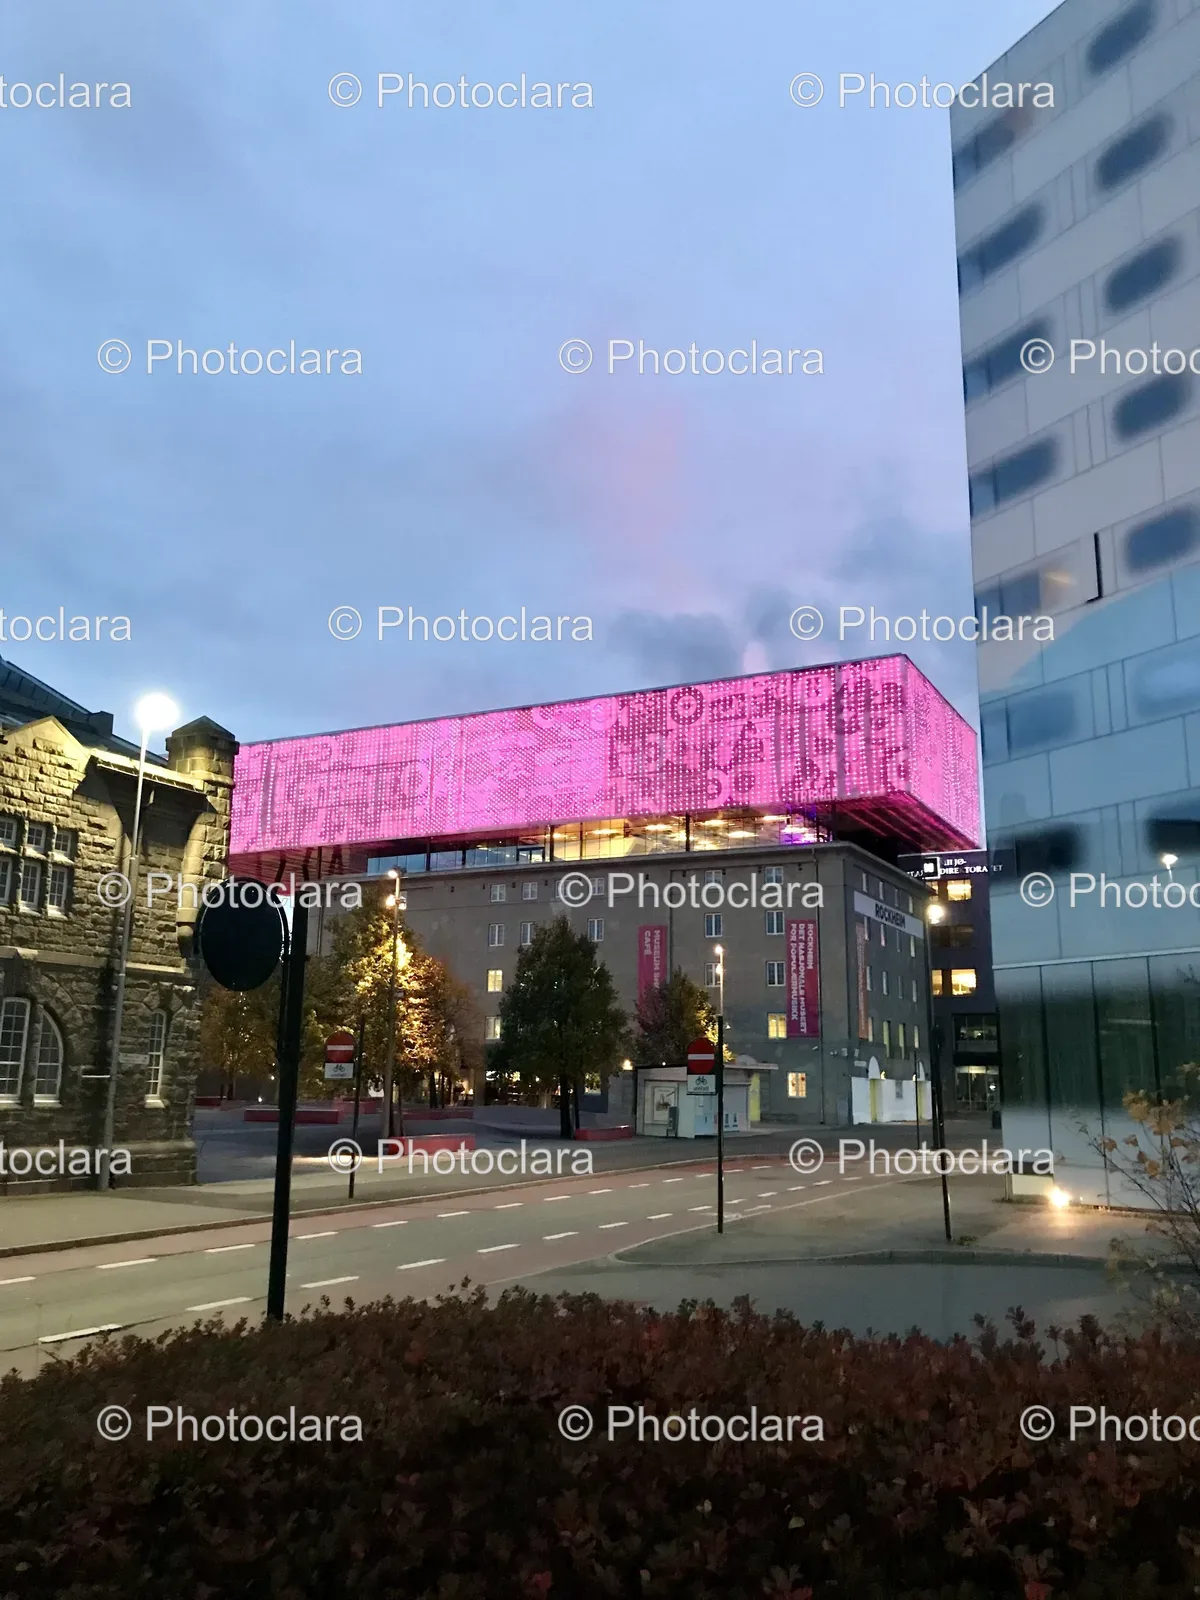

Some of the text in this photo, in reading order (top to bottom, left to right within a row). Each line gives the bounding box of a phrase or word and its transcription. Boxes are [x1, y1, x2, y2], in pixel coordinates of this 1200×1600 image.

[940, 864, 1003, 875] DIRETORAET
[875, 902, 906, 930] ROCKHEIM
[644, 930, 652, 956] CAFÉ
[653, 929, 661, 971] MUSEUM
[806, 923, 814, 970] ROCKHEIM
[790, 943, 799, 1021] POPULÆRMUSIKK
[798, 923, 807, 1034] DET NASJONALE MUSEET
